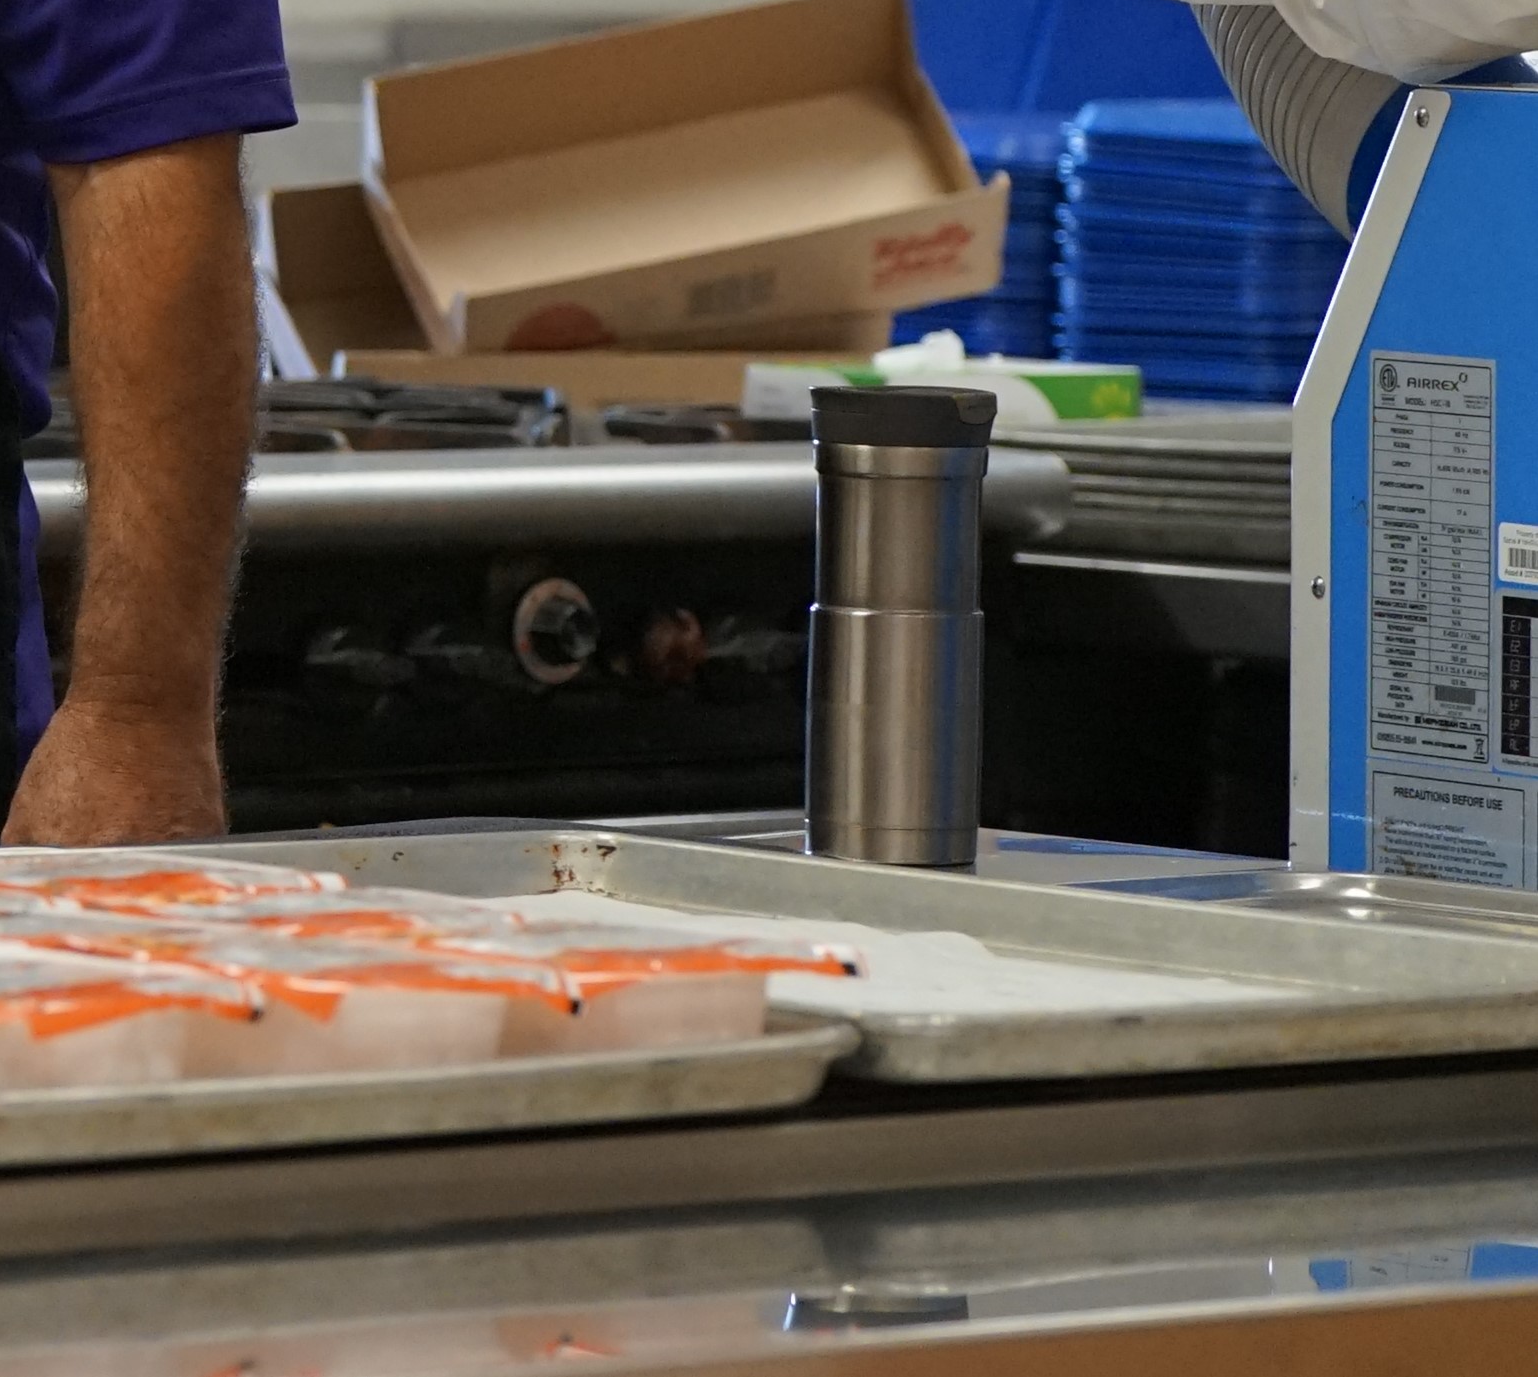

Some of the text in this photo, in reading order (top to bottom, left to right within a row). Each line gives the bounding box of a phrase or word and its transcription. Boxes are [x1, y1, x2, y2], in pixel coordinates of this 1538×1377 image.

[1407, 377, 1459, 392] AIRREX
[1393, 786, 1503, 811] PRECAUTIONS BEFORE USE
